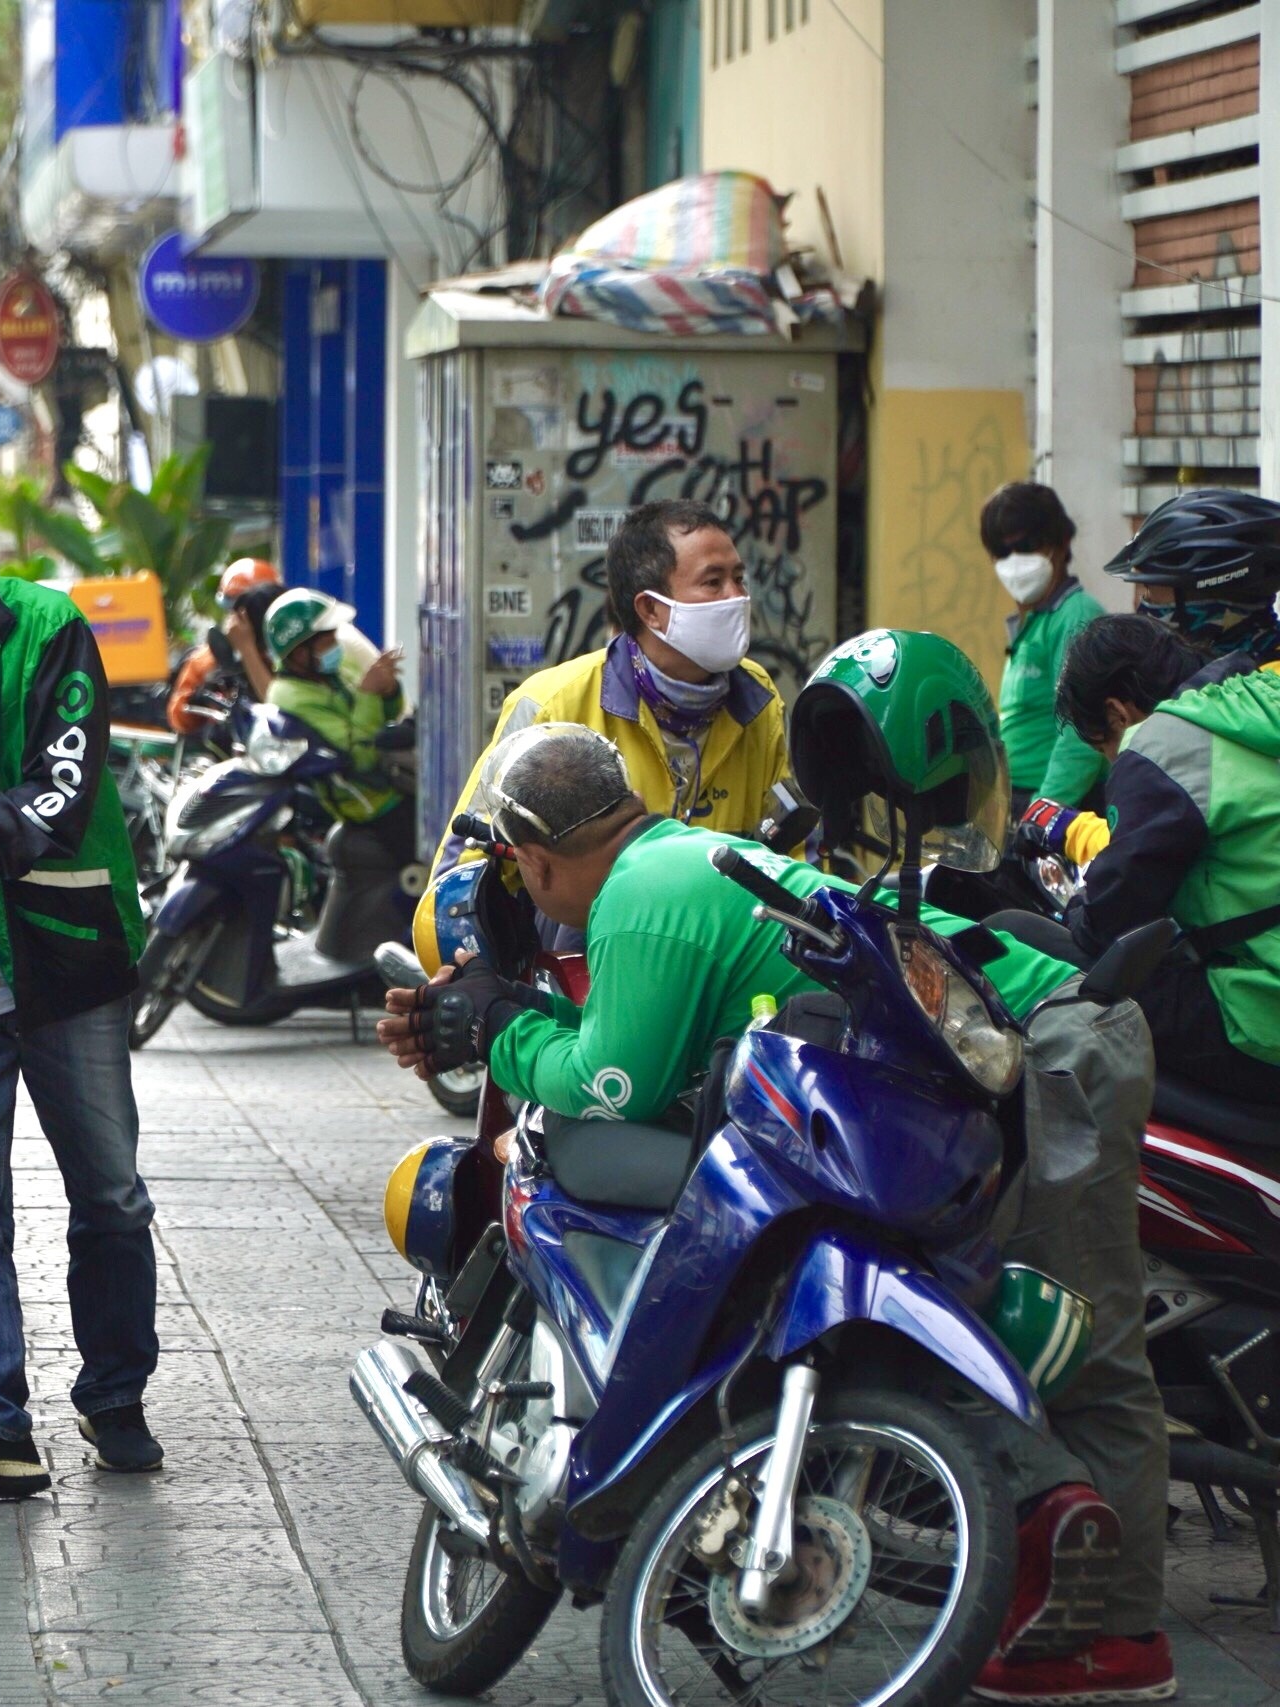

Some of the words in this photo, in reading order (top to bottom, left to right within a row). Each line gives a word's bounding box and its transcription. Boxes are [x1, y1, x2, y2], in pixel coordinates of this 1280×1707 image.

[565, 379, 709, 480] yes
[488, 590, 528, 614] BNE
[713, 787, 729, 800] be
